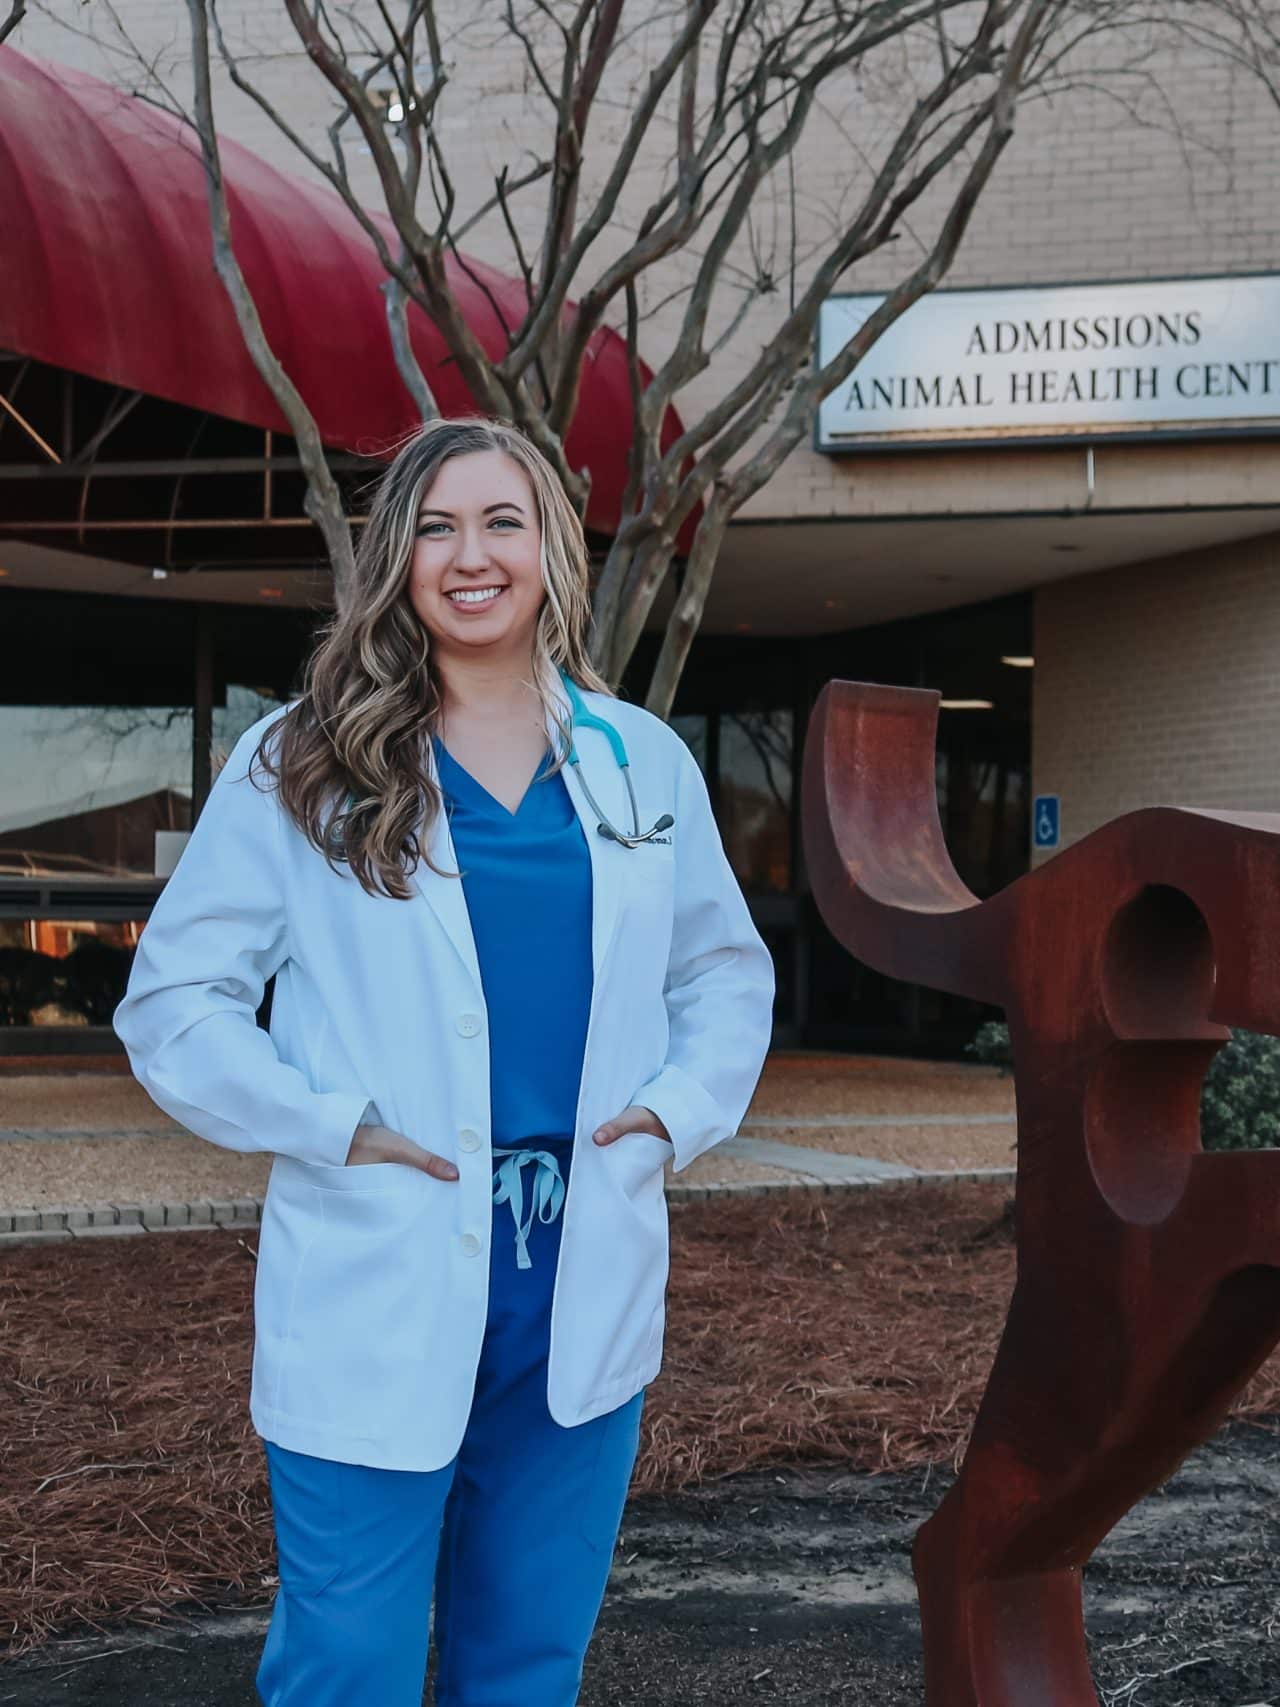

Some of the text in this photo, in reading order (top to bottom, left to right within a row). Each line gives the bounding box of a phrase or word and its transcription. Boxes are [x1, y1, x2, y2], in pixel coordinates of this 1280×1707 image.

[966, 311, 1202, 355] ADMISSIONS
[845, 370, 994, 411] ANIMAL
[1009, 367, 1158, 404] HEALTH
